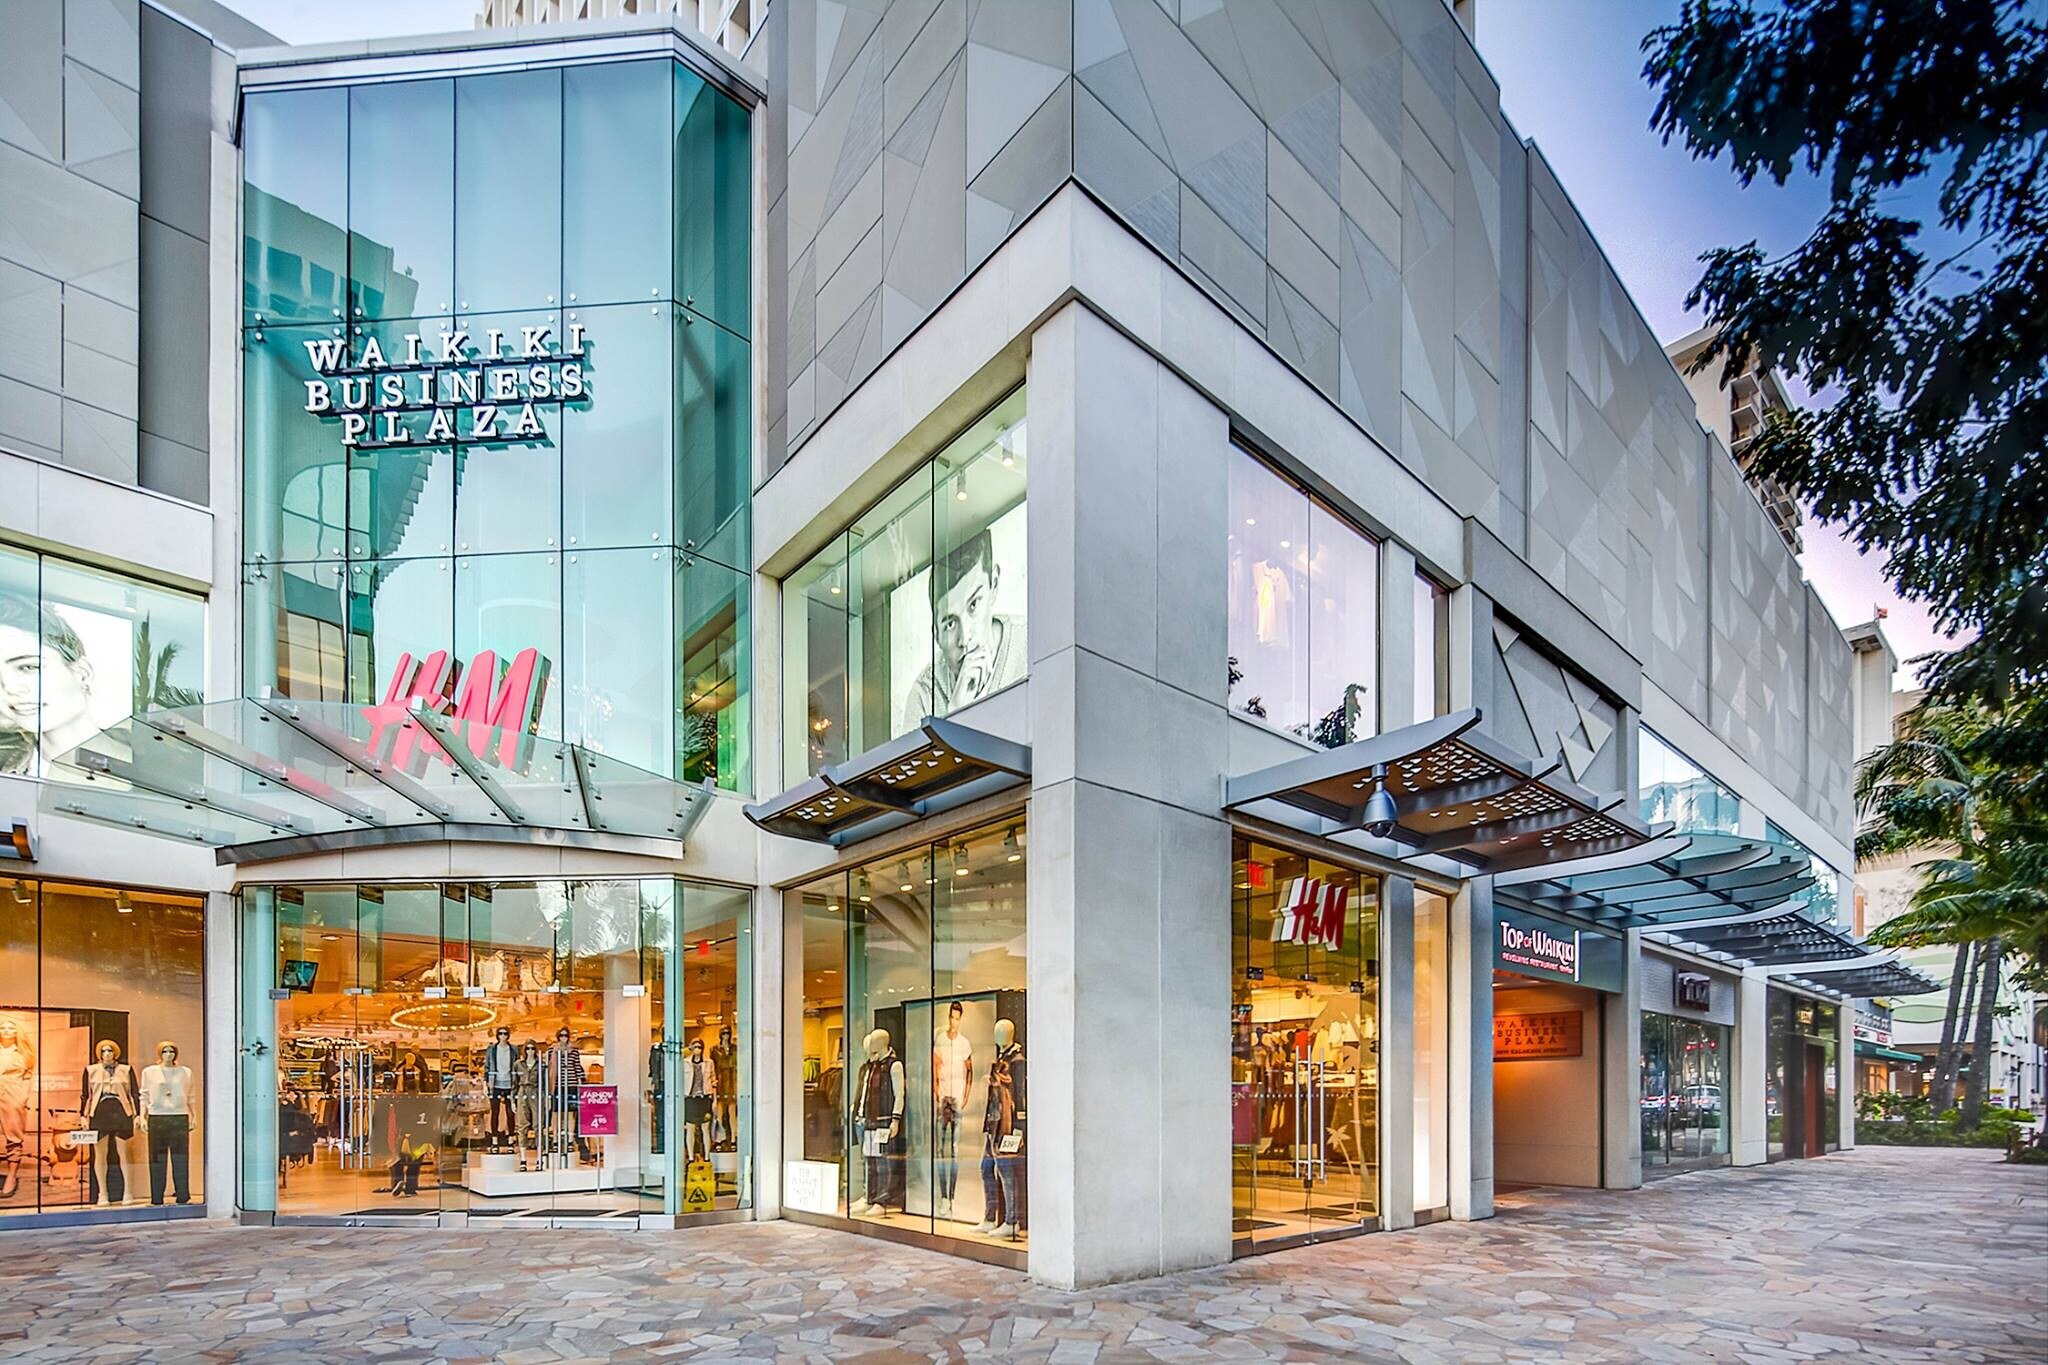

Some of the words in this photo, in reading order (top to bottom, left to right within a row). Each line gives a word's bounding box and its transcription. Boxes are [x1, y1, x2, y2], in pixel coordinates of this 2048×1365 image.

[303, 323, 586, 372] WAIKIKI
[303, 363, 584, 412] BUSINESS
[341, 402, 543, 445] PLAZA
[361, 647, 538, 770] H&M
[1282, 875, 1349, 951] H&M
[1496, 1017, 1567, 1028] WAIKIKI
[1497, 1026, 1566, 1038] BUSINESS
[1504, 1035, 1557, 1046] PLAZA
